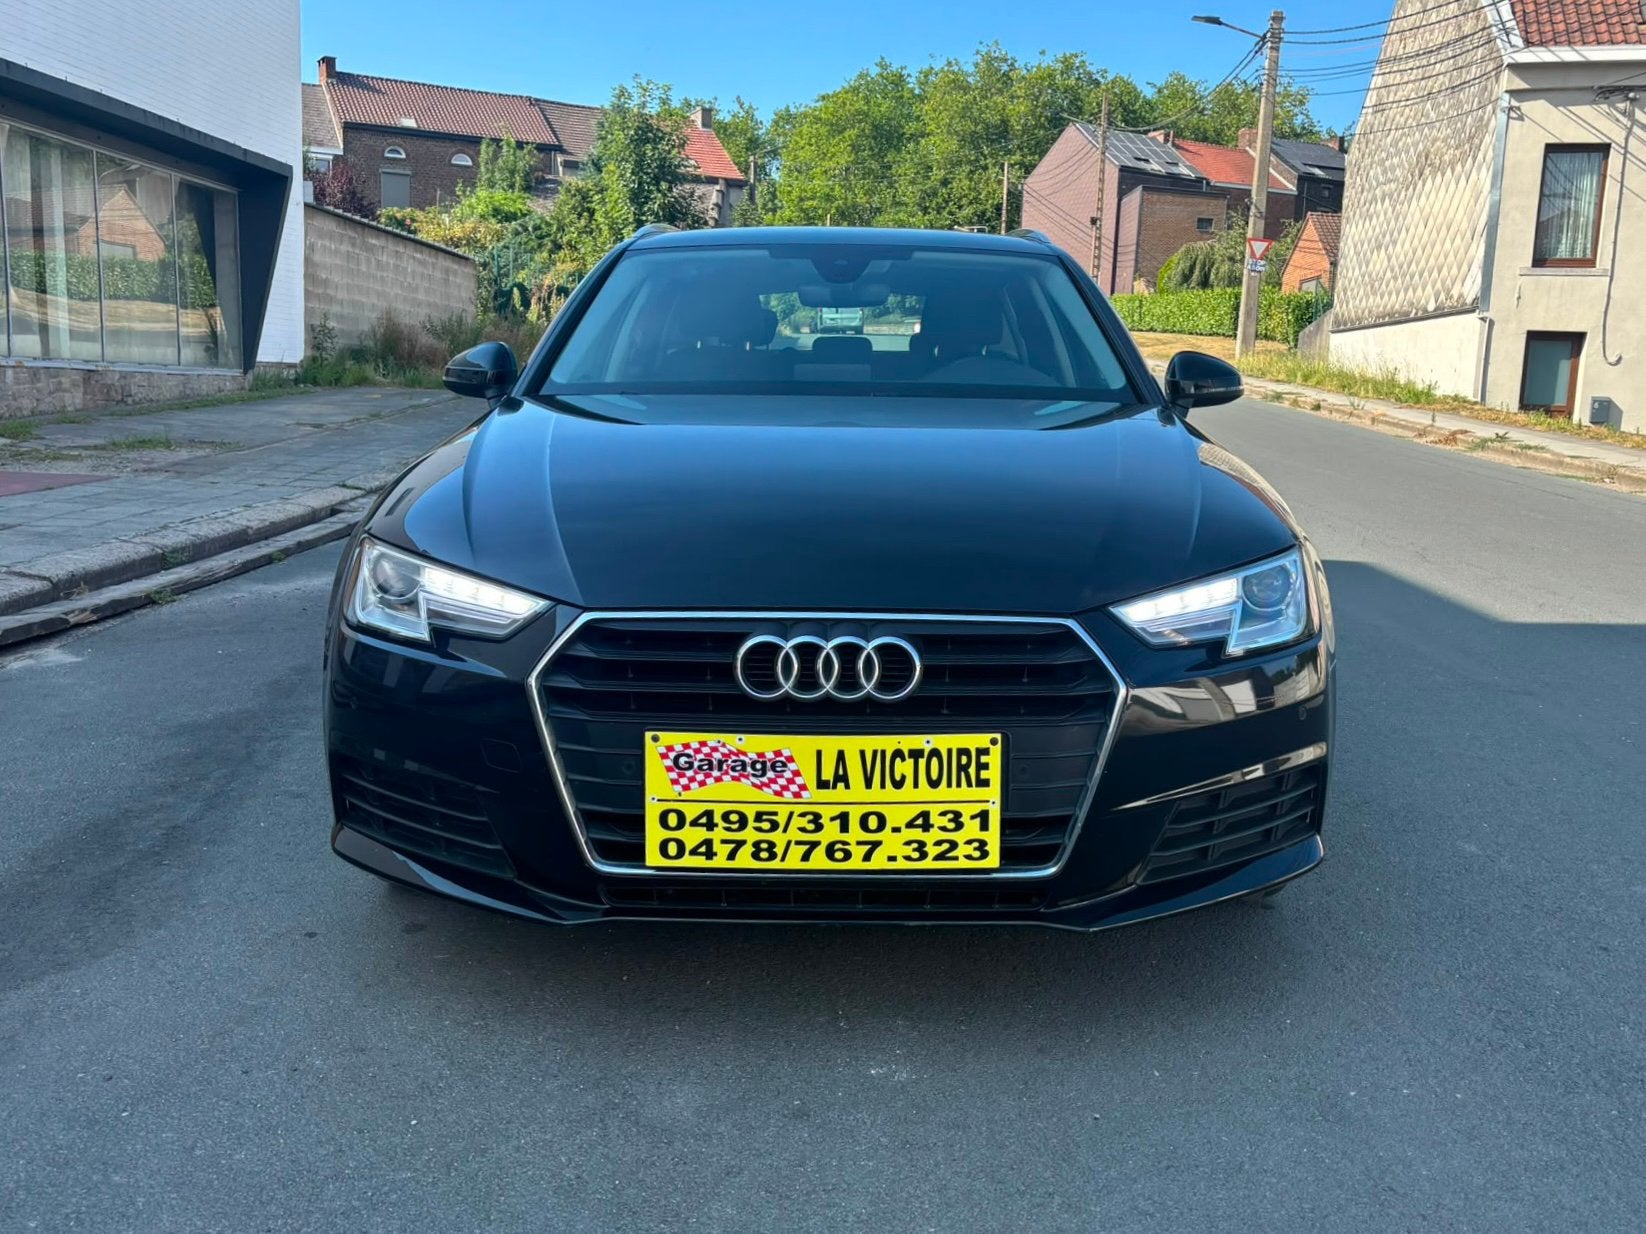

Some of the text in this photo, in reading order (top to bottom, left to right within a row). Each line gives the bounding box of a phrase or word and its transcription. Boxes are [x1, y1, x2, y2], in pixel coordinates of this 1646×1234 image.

[672, 752, 788, 778] Garage
[815, 747, 991, 790] LA VICTOIRE
[658, 808, 990, 834] 0495/310.431
[658, 837, 990, 863] 0478/767.323
